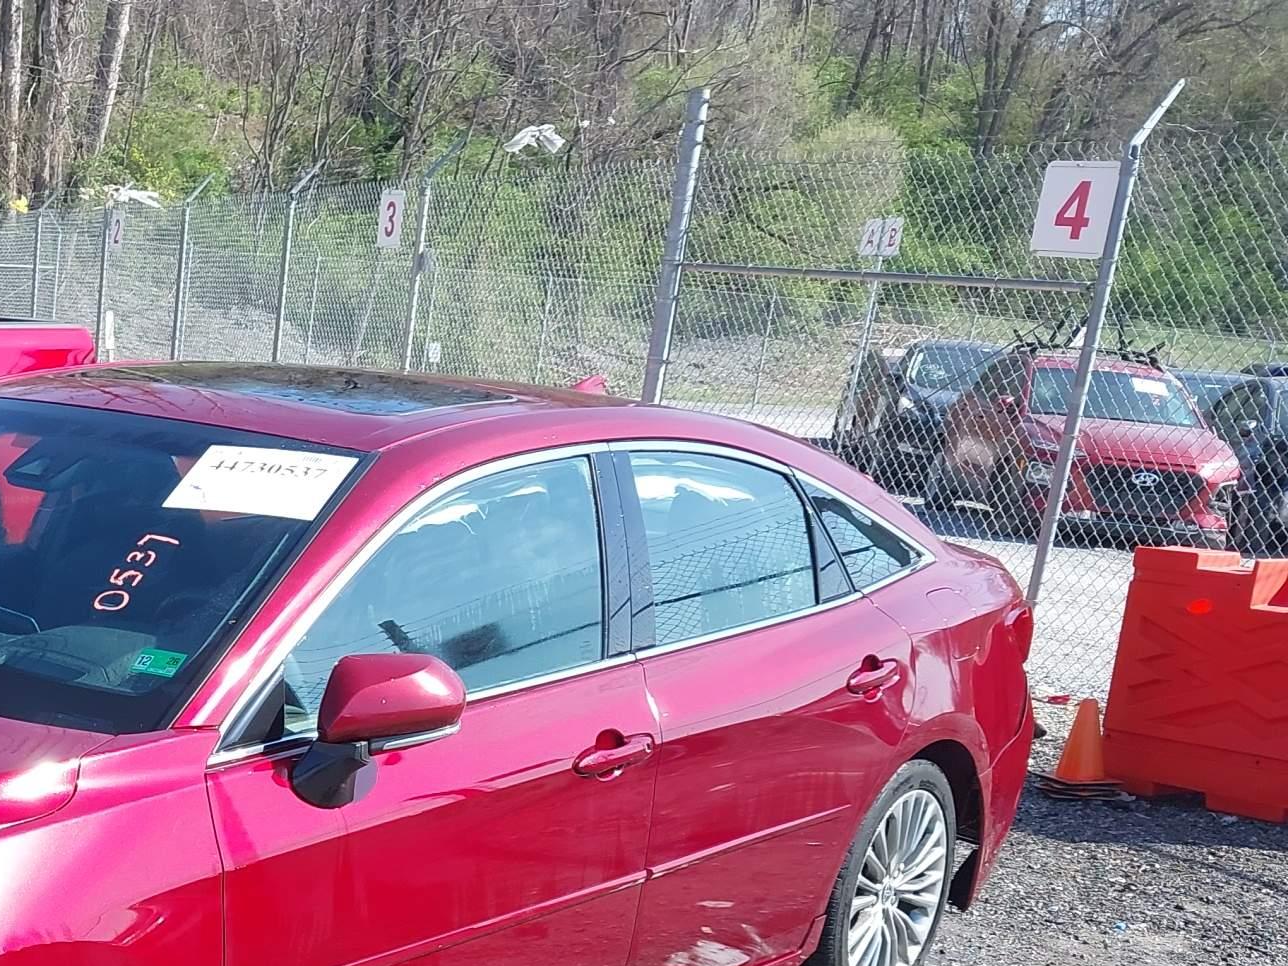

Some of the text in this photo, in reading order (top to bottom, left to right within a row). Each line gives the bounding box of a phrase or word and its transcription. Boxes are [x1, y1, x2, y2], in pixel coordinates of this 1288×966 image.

[384, 201, 397, 238] 3
[1054, 180, 1092, 240] 4
[113, 219, 121, 244] 2
[864, 228, 875, 248] A
[887, 227, 898, 248] B
[209, 460, 328, 479] 44730537
[93, 533, 180, 611] 0537
[136, 655, 153, 666] 12
